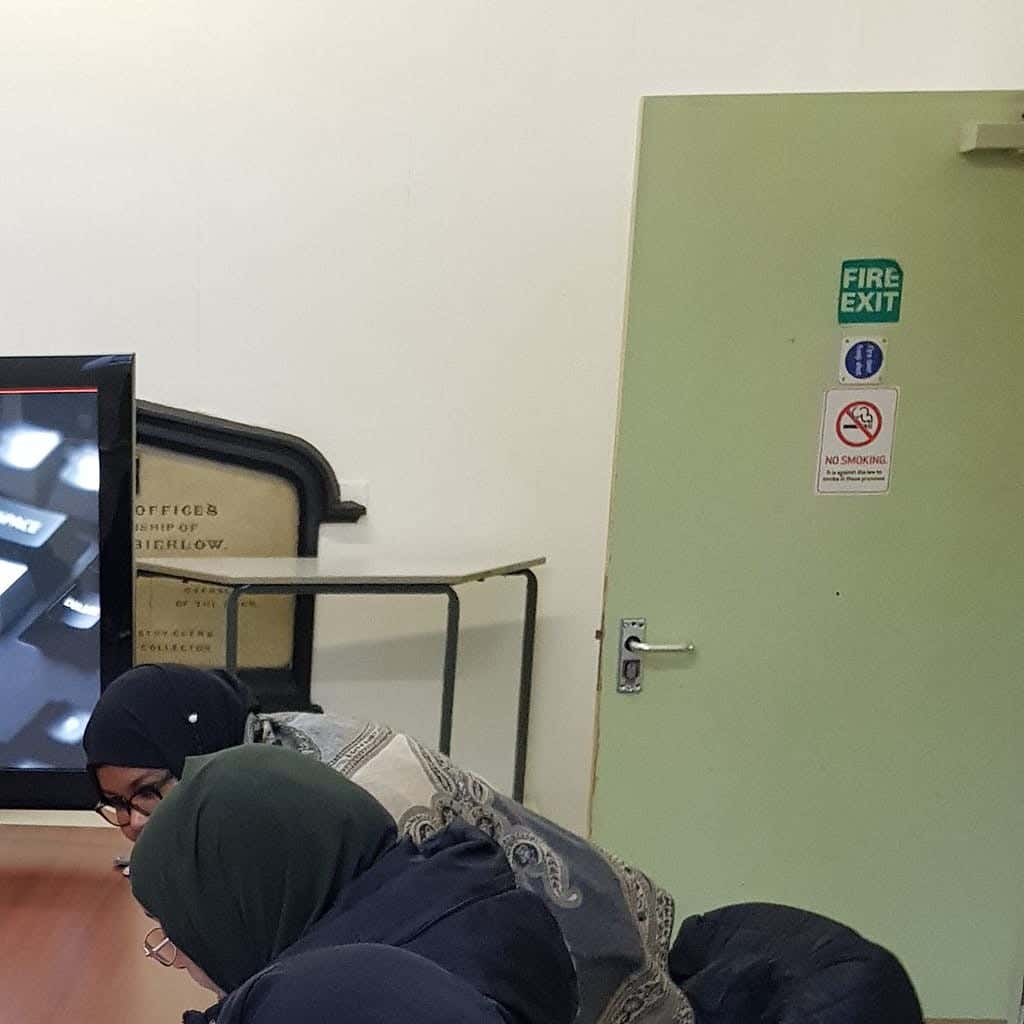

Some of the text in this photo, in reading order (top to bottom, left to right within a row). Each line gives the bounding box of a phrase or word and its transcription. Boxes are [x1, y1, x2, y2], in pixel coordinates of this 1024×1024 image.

[843, 267, 899, 288] FIRE
[840, 291, 899, 312] EXIT
[825, 455, 888, 465] NO SMOKING
[135, 504, 218, 516] OFFICES
[178, 523, 198, 533] OF
